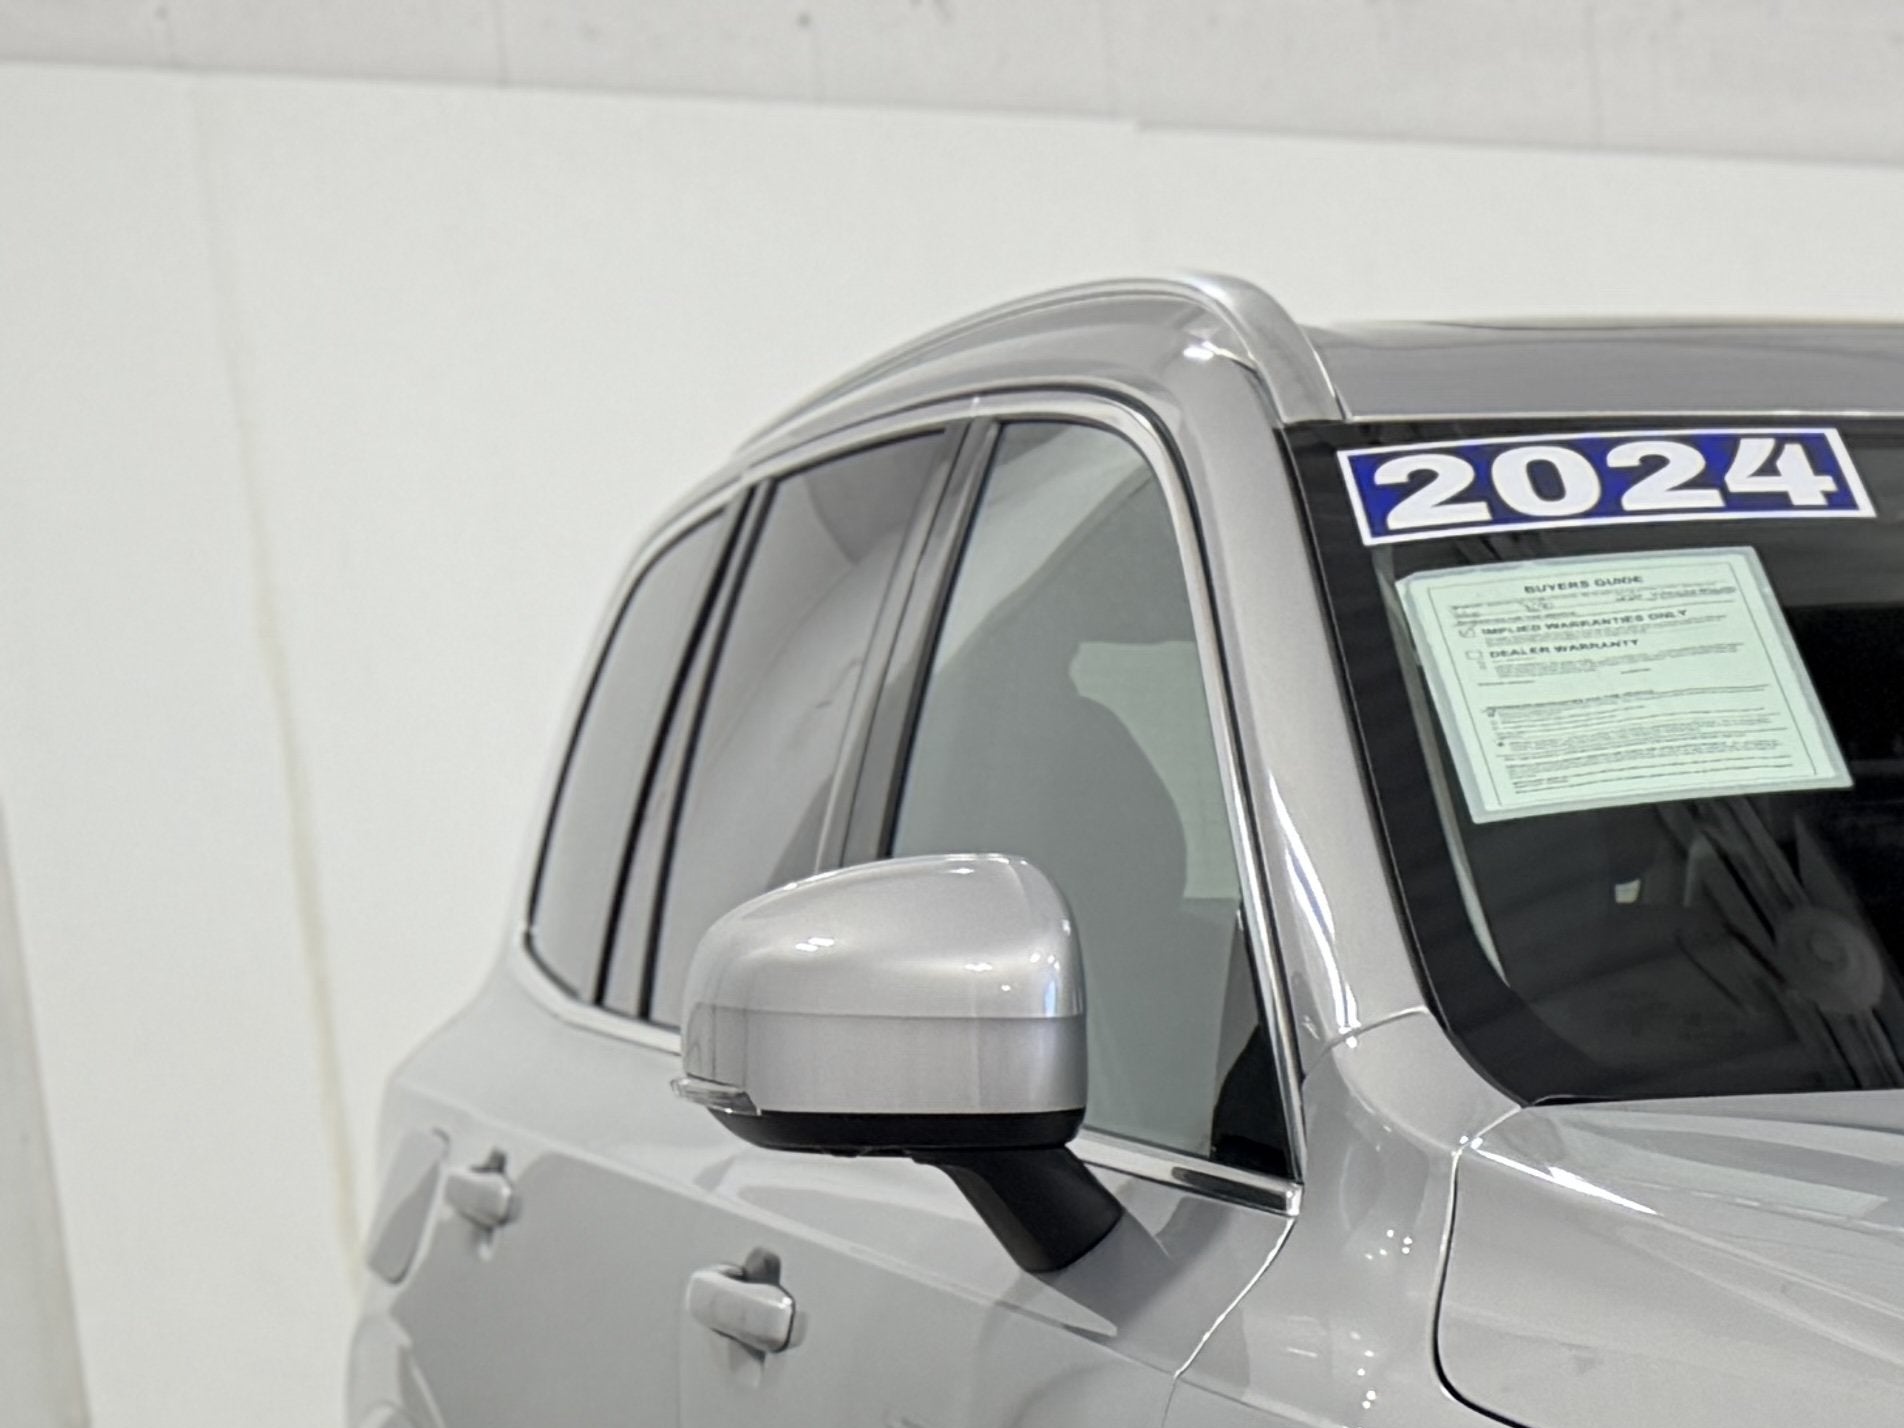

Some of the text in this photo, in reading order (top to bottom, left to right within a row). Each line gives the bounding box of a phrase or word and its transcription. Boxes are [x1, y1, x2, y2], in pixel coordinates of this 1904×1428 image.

[1373, 437, 1838, 530] 2024
[1524, 575, 1644, 594] BUYERS GUIDE
[1481, 623, 1541, 635] IMPLIED
[1546, 613, 1645, 631] WARRANTIES
[1648, 609, 1688, 621] ONLY
[1489, 646, 1550, 659] DEALER
[1554, 638, 1640, 653] WARRANTY
